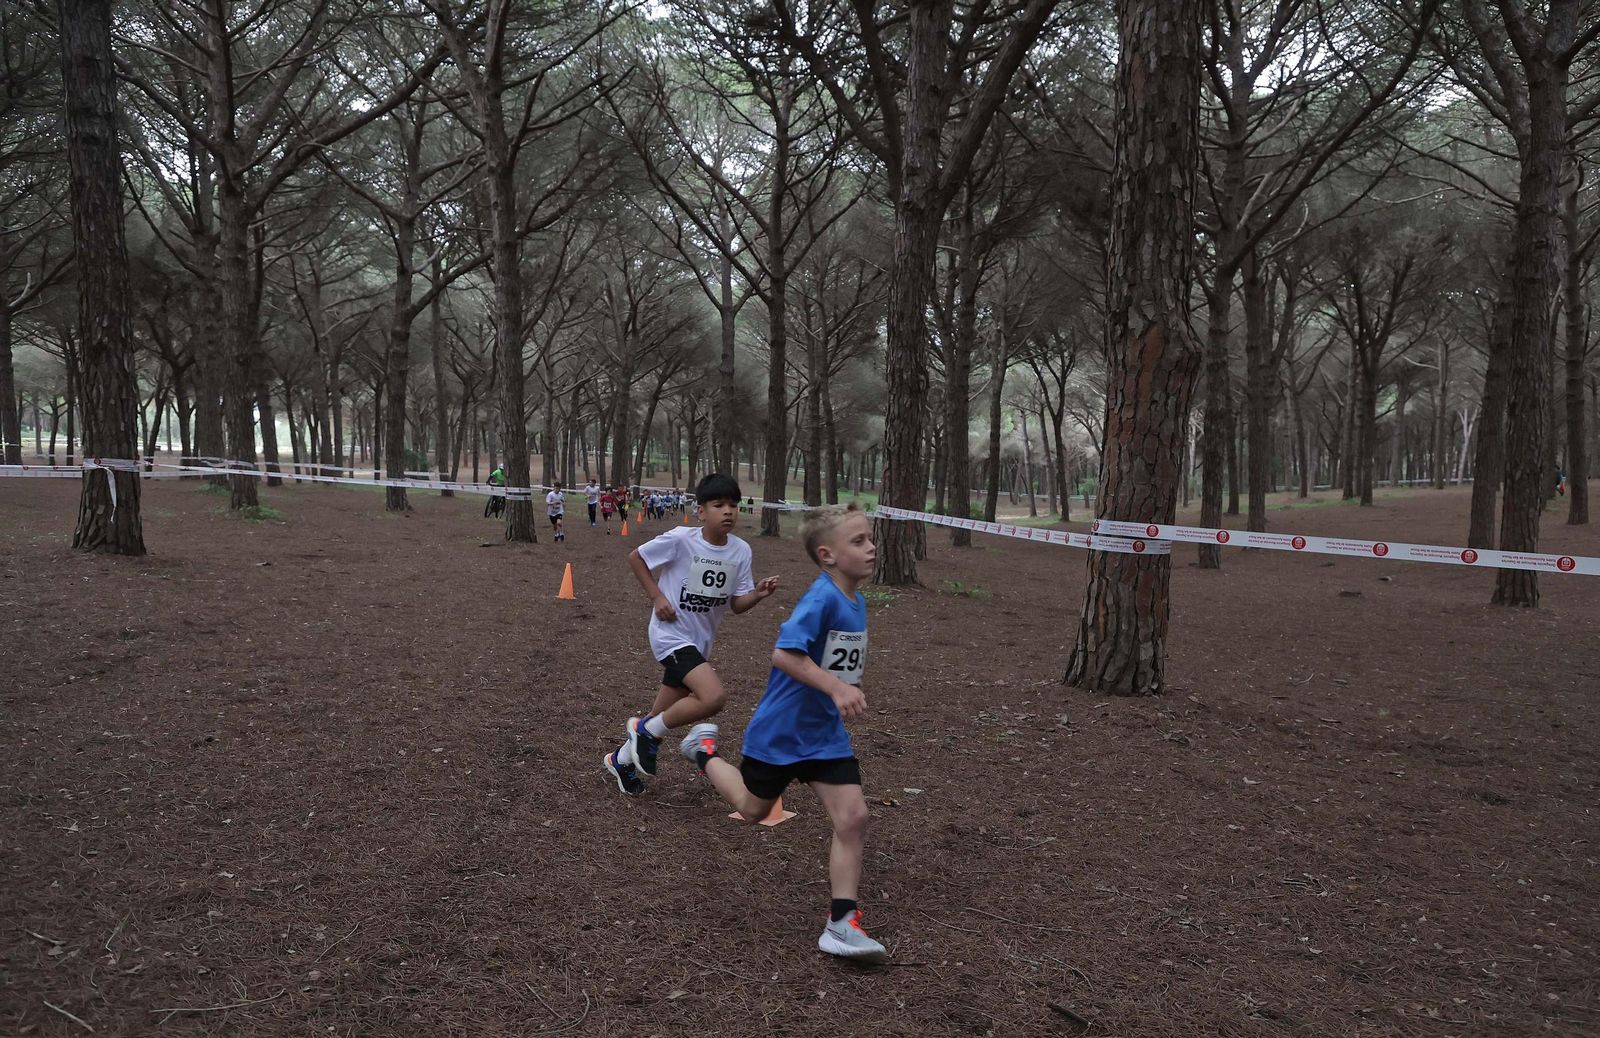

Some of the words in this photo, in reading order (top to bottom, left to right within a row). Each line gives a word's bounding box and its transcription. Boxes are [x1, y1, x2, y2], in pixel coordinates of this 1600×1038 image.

[700, 558, 722, 566] CROSS
[702, 570, 727, 588] 69
[839, 634, 863, 642] CROSS
[828, 647, 863, 672] 29
